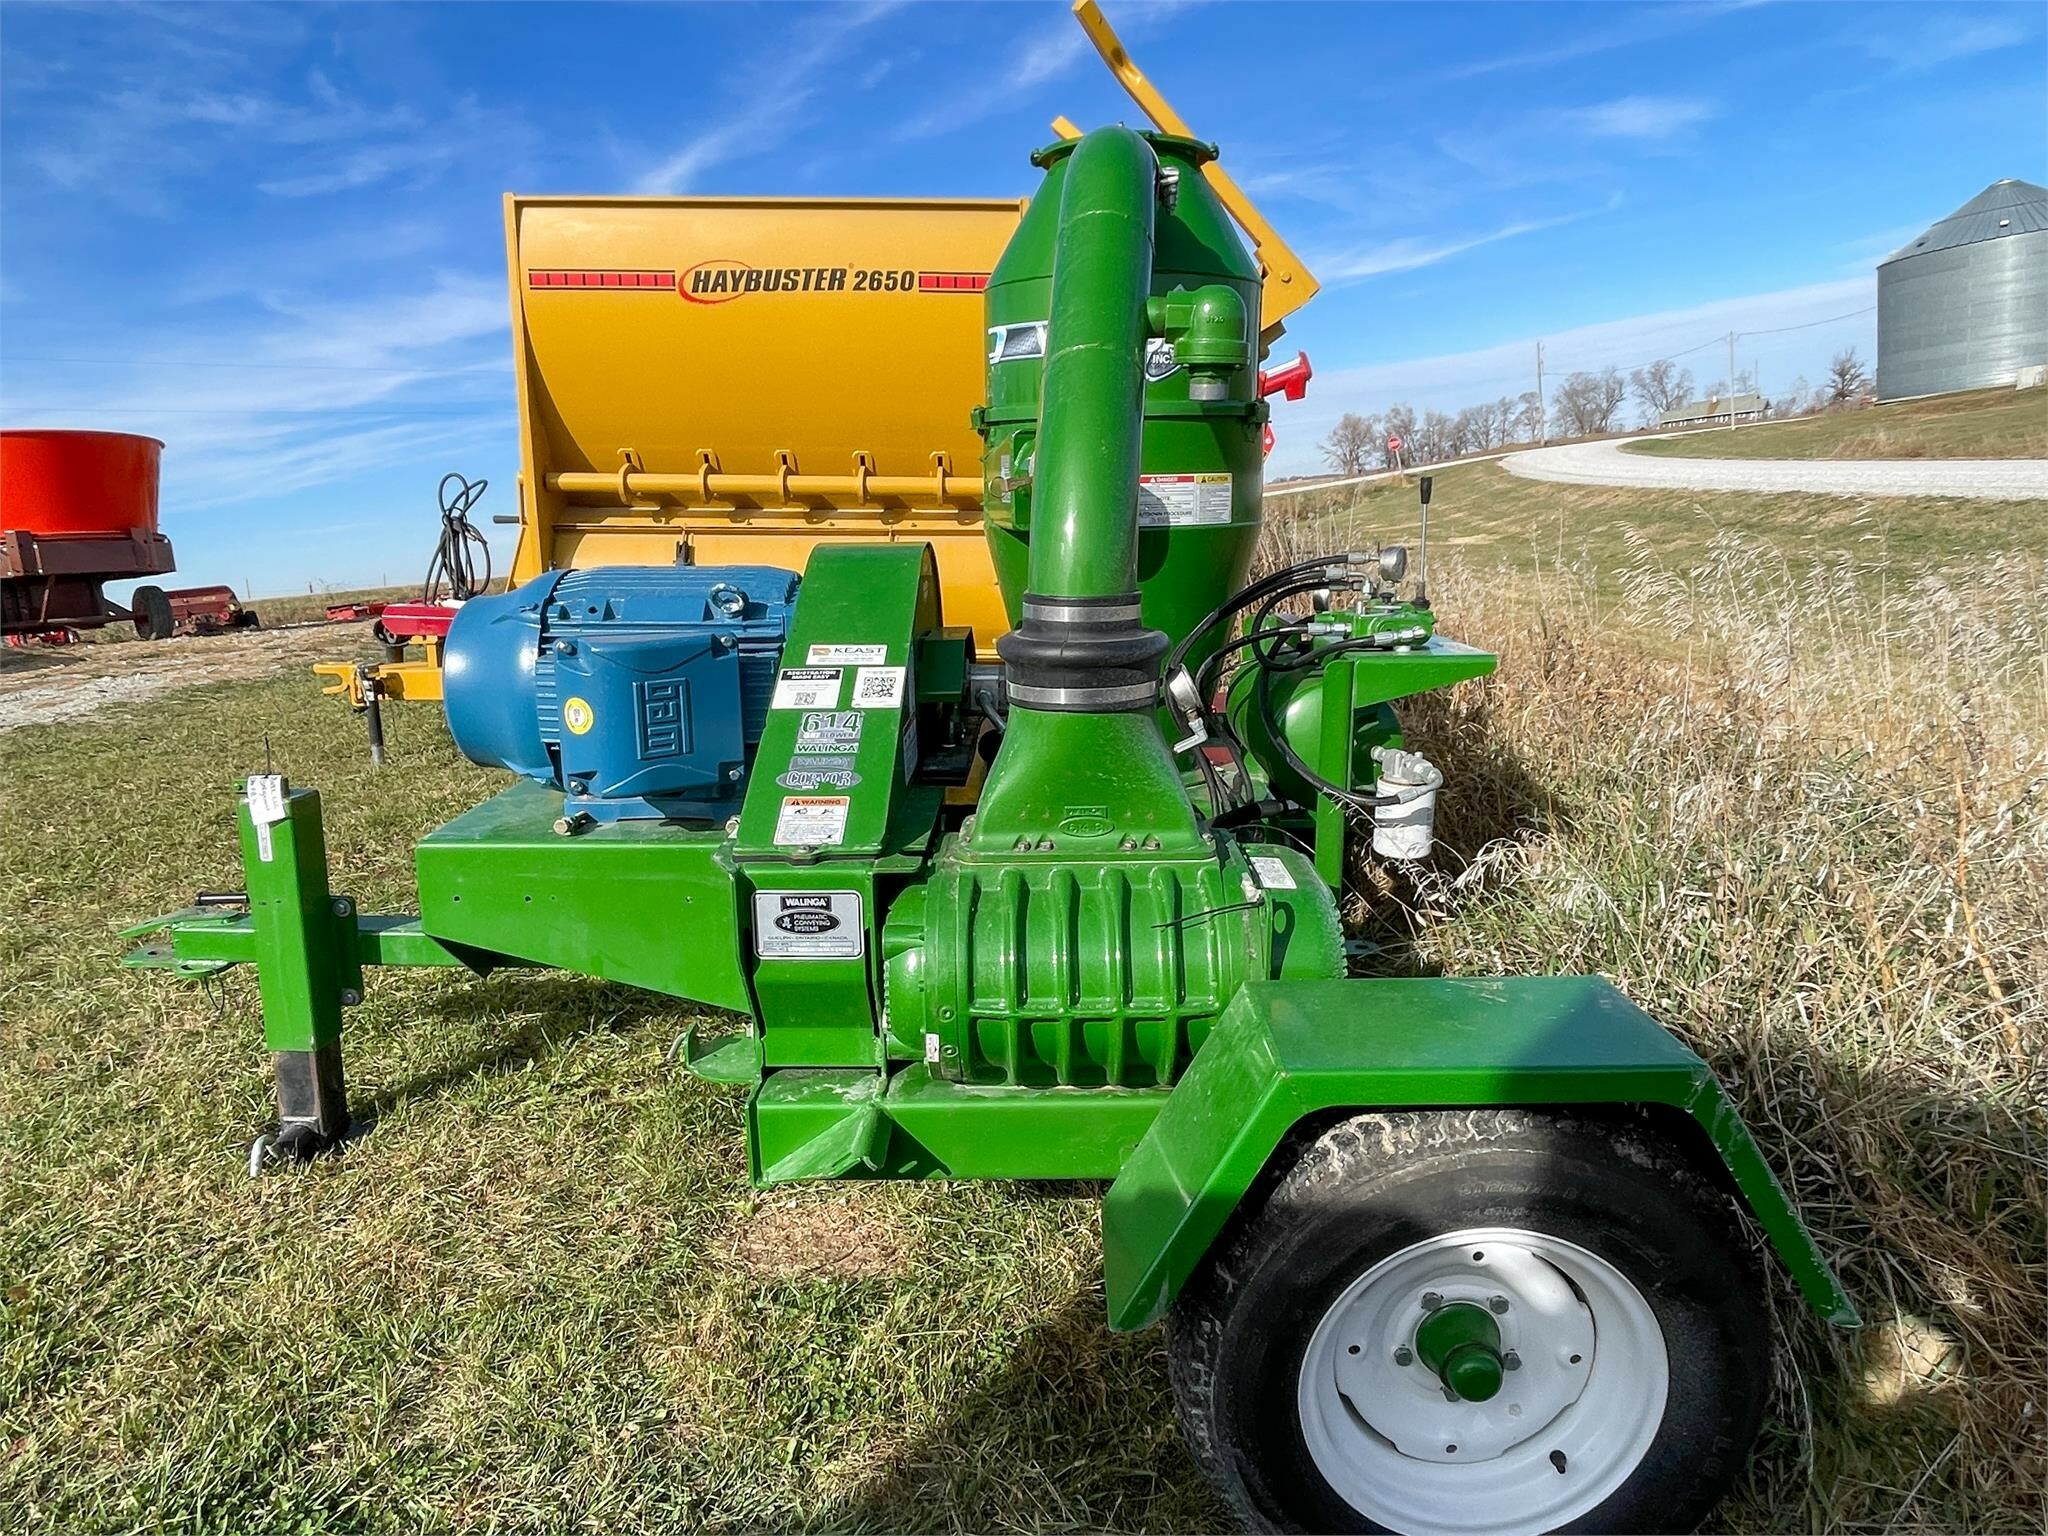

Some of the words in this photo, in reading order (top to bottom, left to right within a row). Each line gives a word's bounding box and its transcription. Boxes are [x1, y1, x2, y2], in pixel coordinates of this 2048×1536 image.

[691, 268, 847, 292] HAYBUSTER
[852, 270, 915, 292] 2650
[802, 712, 860, 733] 614
[797, 744, 856, 752] WALINGA
[785, 898, 826, 906] WALINGA
